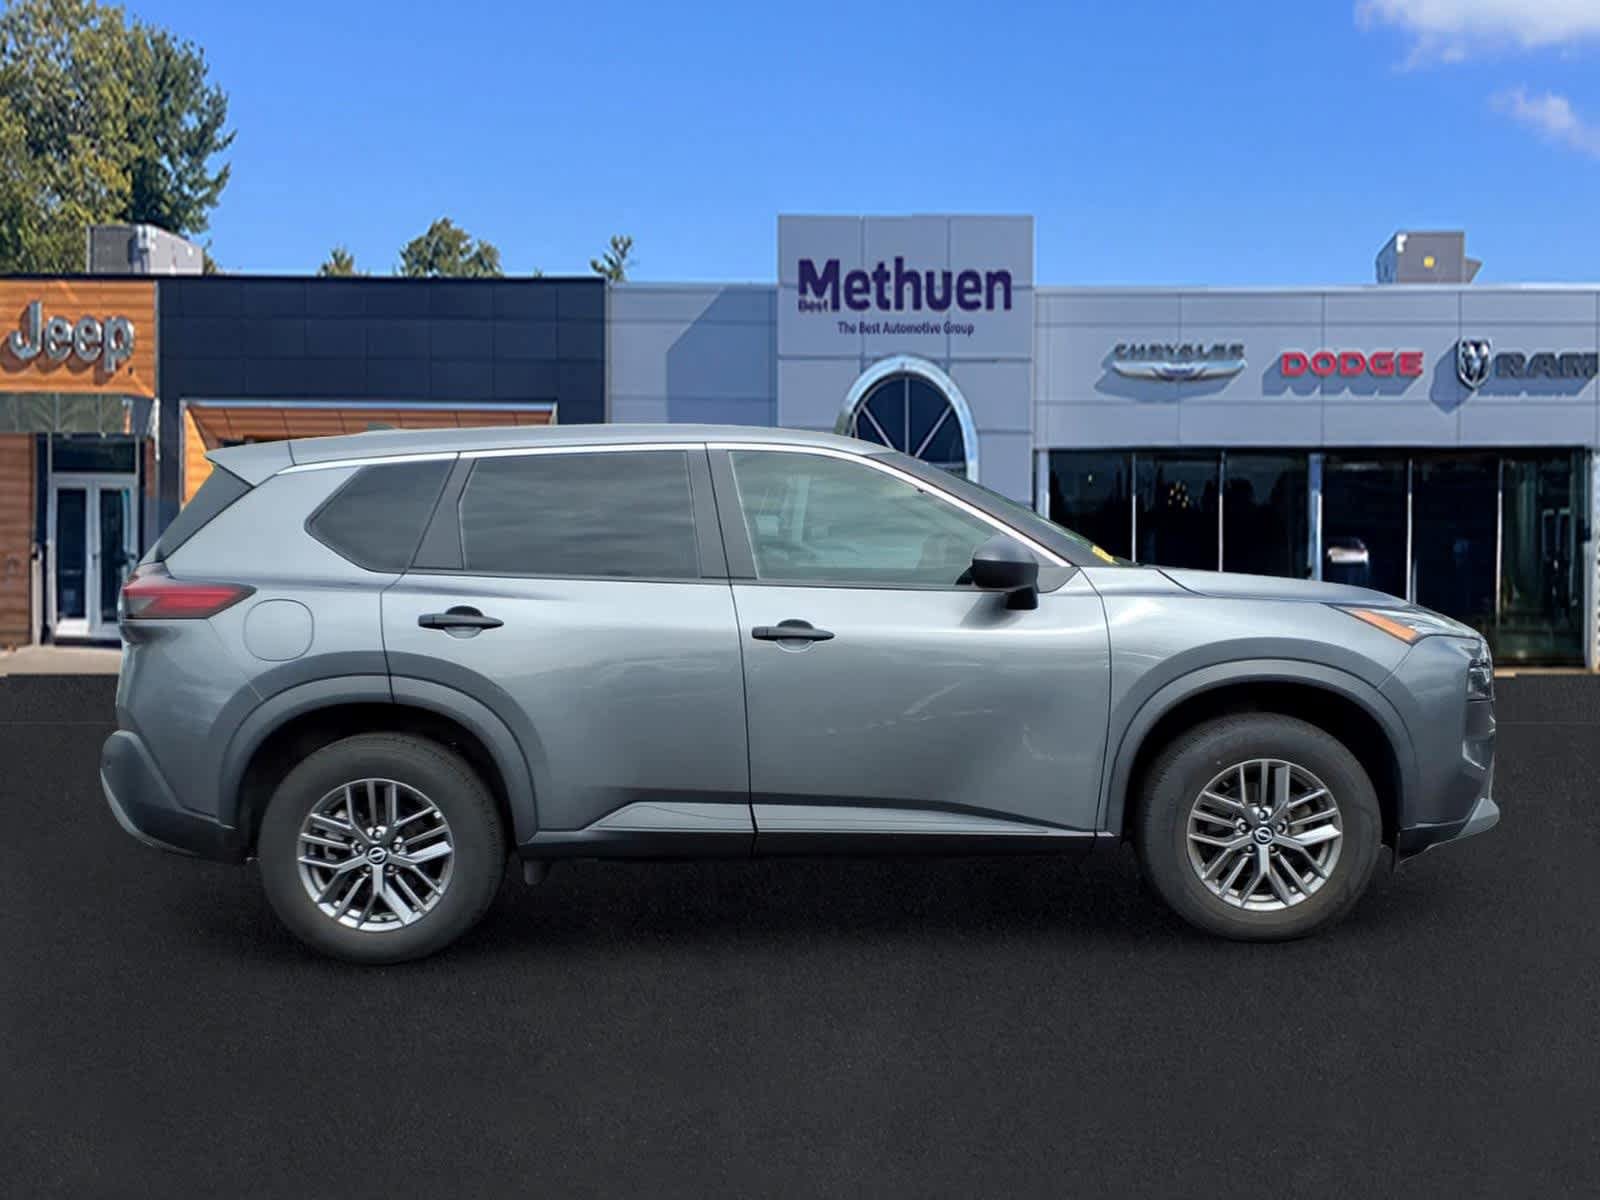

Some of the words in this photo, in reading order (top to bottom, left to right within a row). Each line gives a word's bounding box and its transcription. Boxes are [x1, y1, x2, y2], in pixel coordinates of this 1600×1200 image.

[798, 256, 1012, 312] Methuen
[798, 299, 828, 313] Best
[9, 300, 135, 373] Jeep
[839, 322, 857, 335] The
[859, 321, 881, 335] Best
[883, 321, 941, 335] Automotive
[943, 320, 975, 337] Group
[1281, 351, 1424, 377] DODGE
[1495, 352, 1599, 378] RAM
